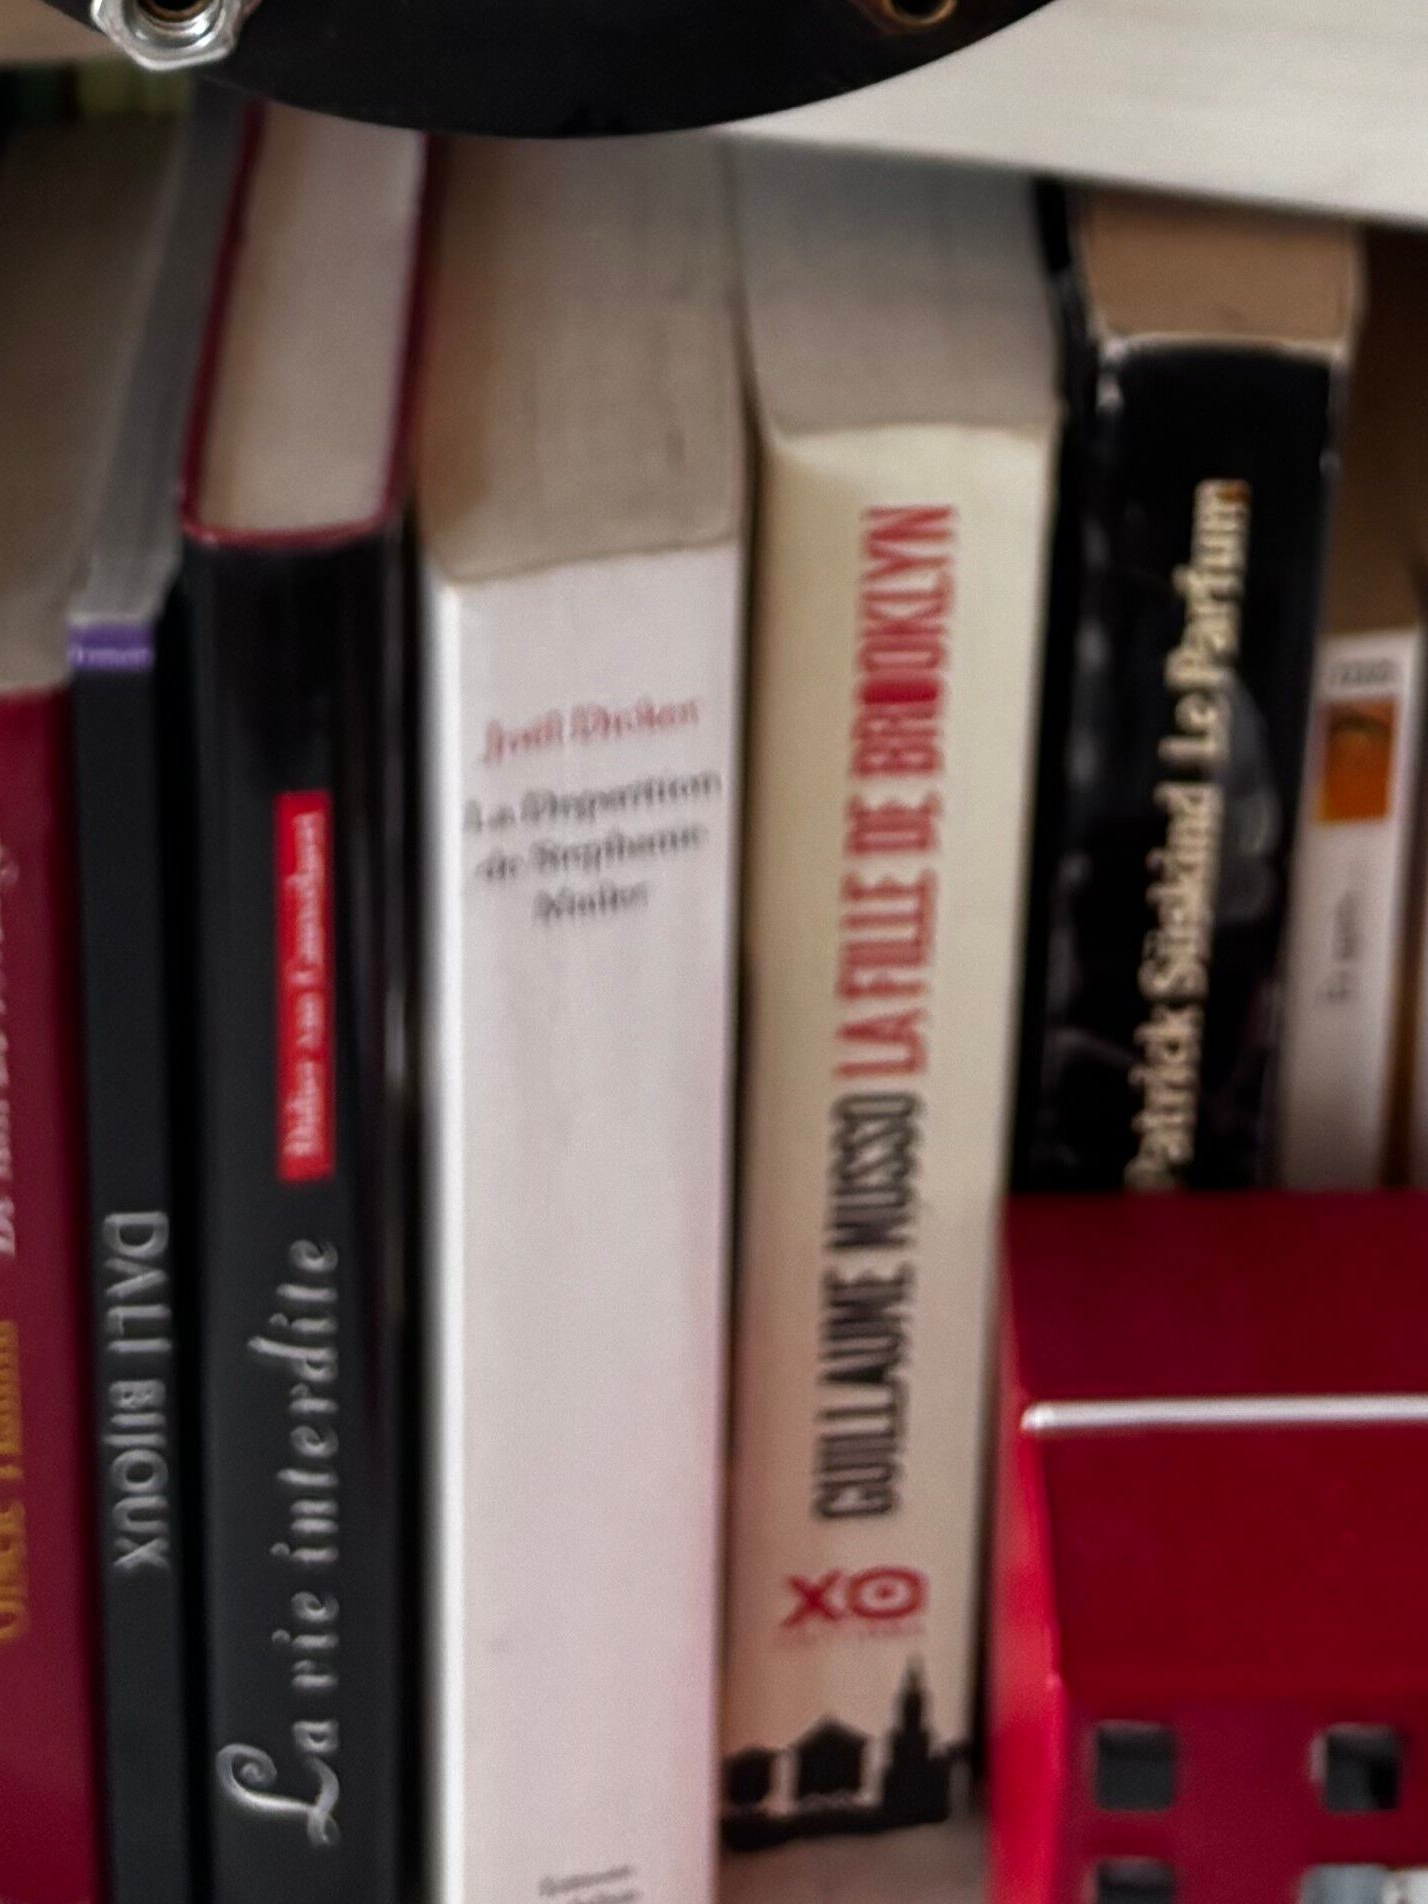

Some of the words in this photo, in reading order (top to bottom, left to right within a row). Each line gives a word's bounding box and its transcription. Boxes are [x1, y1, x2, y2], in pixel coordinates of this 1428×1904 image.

[846, 504, 958, 779] BROOKLYN
[1165, 478, 1250, 689] Parfum
[1158, 692, 1222, 761] Le
[841, 794, 942, 859] DE
[834, 872, 937, 1003] FILLE
[832, 1009, 928, 1080] LA
[1124, 1004, 1199, 1190] Patrick
[821, 1091, 924, 1255] MUSSO
[247, 1239, 340, 1565] interdite
[809, 1259, 913, 1522] GUILLAUME
[106, 1377, 170, 1572] BIJOUX
[272, 1589, 339, 1689] vie
[216, 1718, 340, 1846] La
